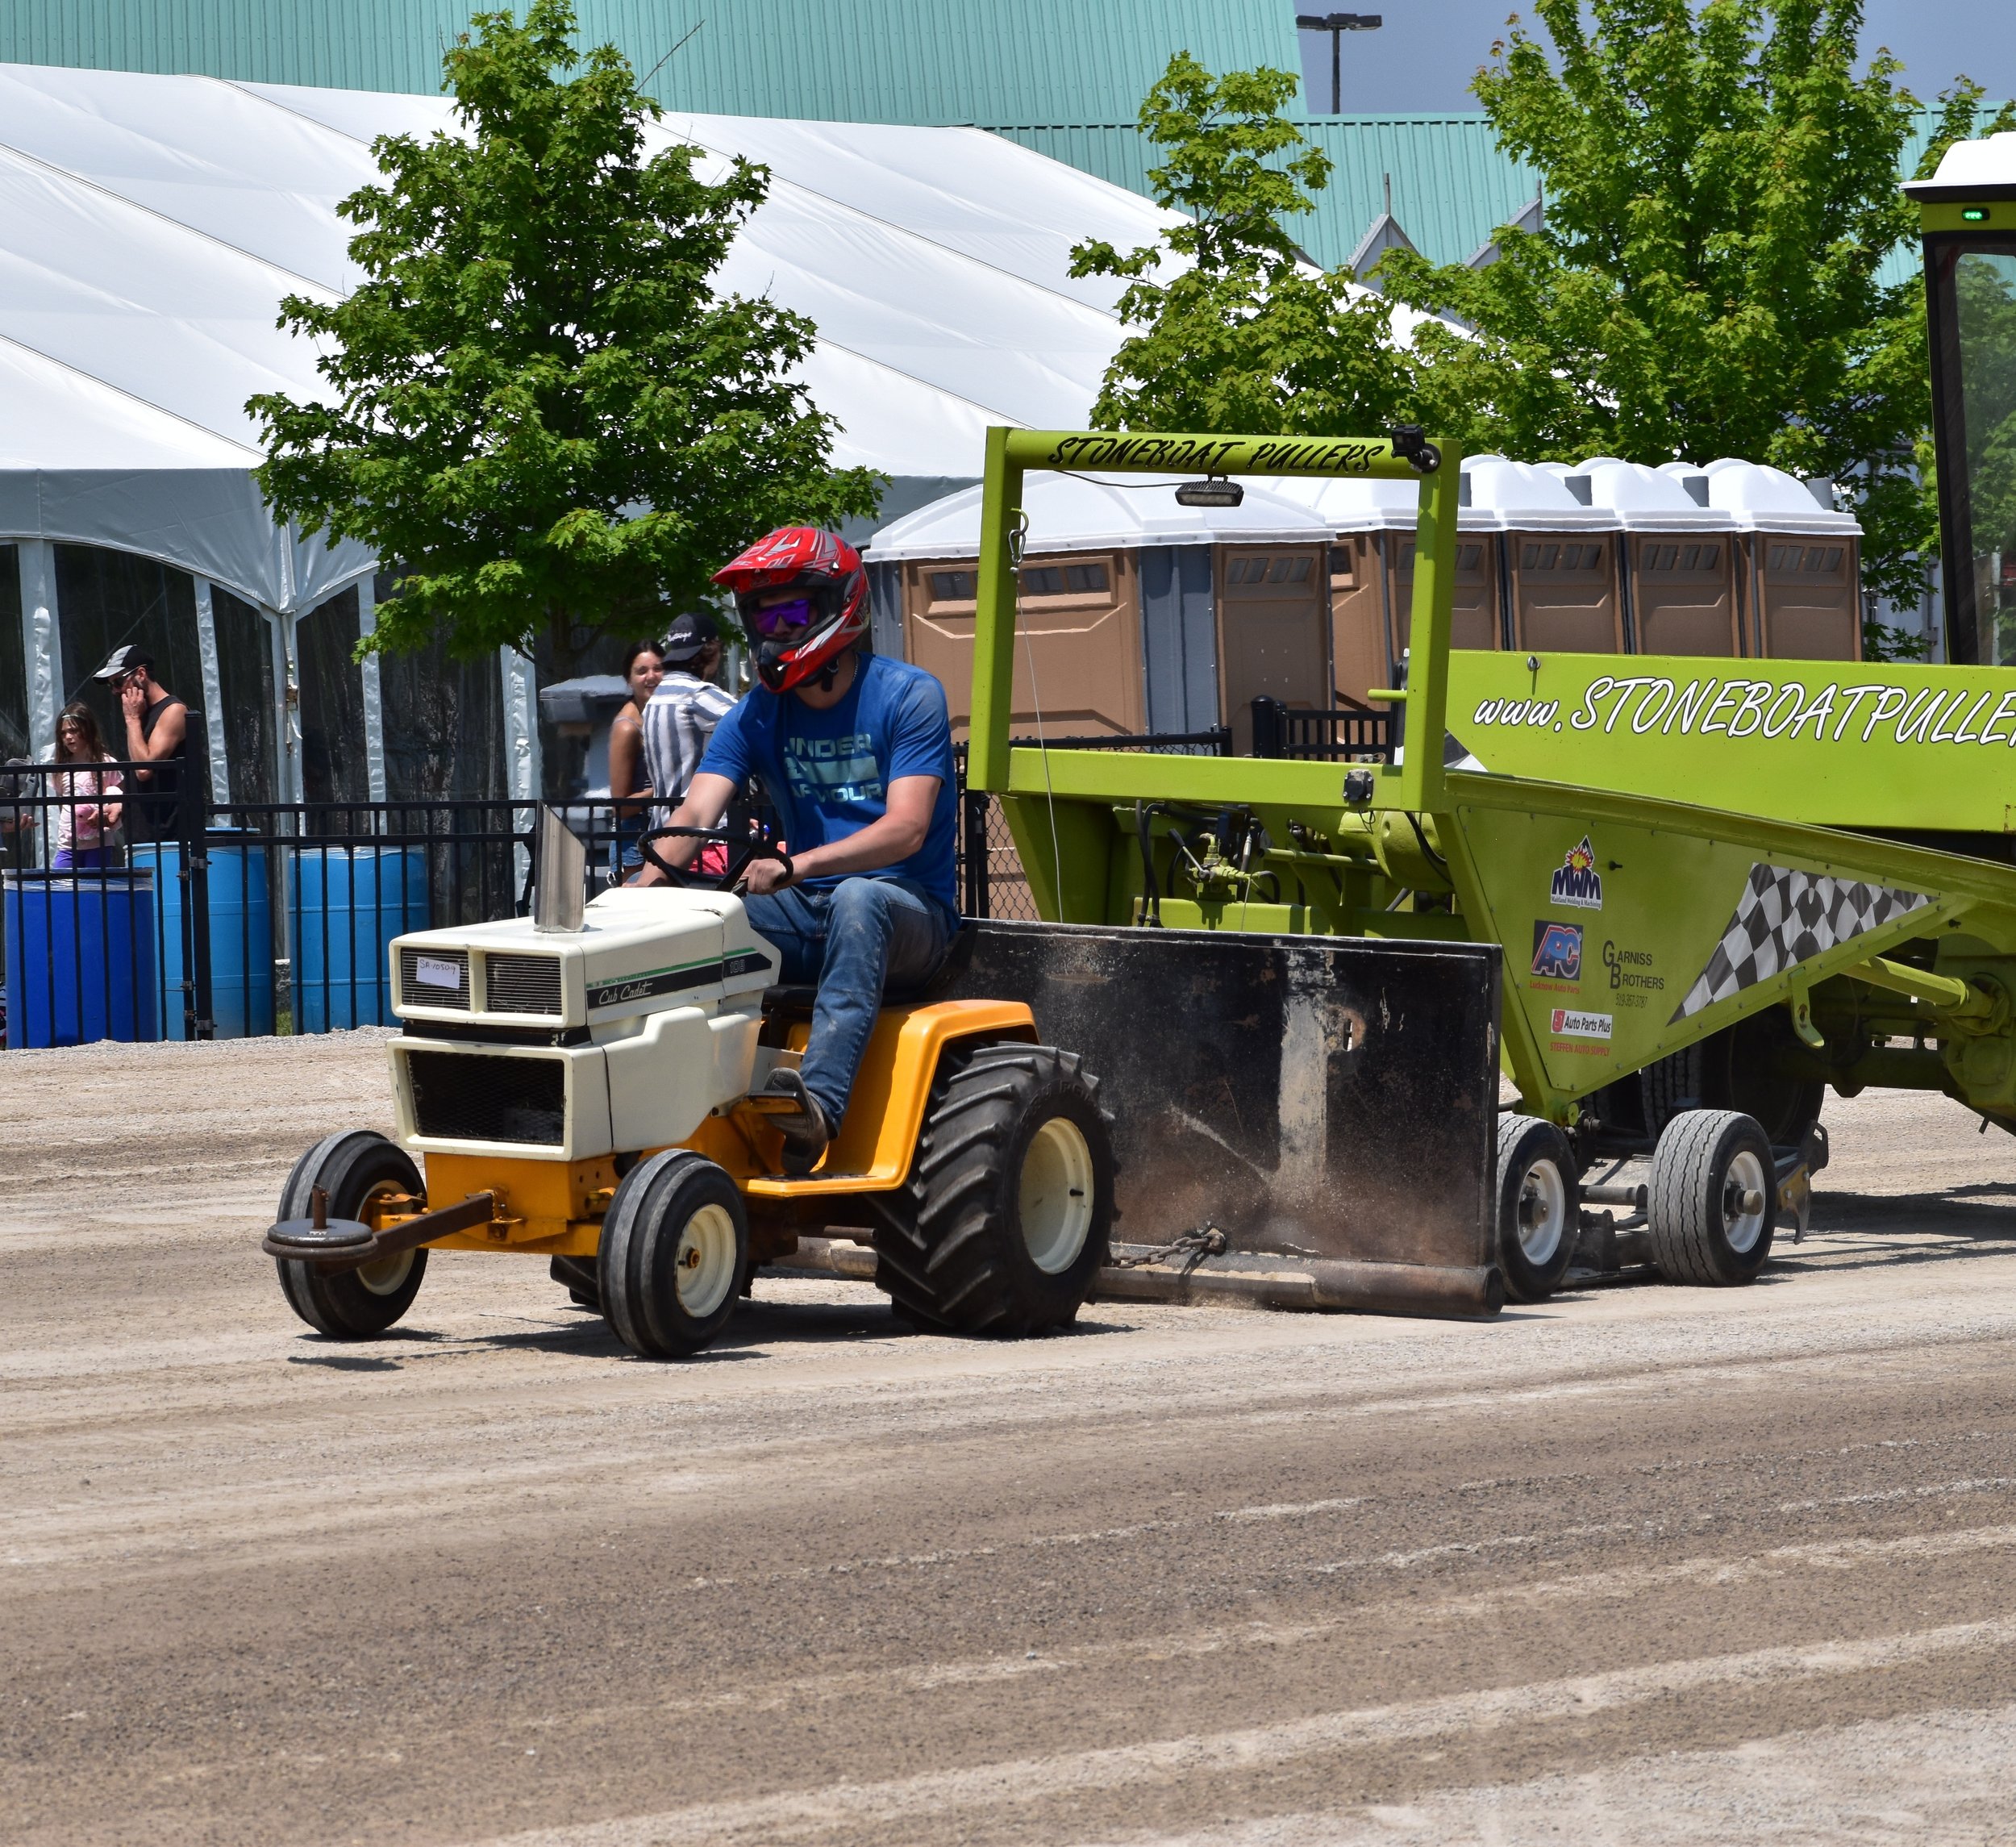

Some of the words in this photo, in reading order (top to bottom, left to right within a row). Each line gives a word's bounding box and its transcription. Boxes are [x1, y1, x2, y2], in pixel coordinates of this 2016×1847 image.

[1049, 436, 1247, 469] STONEBOAT
[1246, 441, 1385, 473] PULLERS
[1472, 675, 2016, 748] www.STONEBOATPULLE
[1551, 863, 1602, 900] MWM
[1531, 924, 1581, 978] APC
[1602, 940, 1653, 967] GARNISS
[729, 959, 746, 974] 108
[1610, 963, 1665, 990] BROTHERS
[598, 989, 619, 1006] Cub
[619, 981, 653, 1001] Cadet
[1530, 980, 1552, 991] Lucknow
[1553, 983, 1566, 992] Auto
[1567, 984, 1581, 994] Parts
[1564, 1015, 1581, 1030] Auto
[1581, 1017, 1597, 1032] Parts
[1597, 1019, 1611, 1033] Plus
[1574, 1044, 1589, 1054] AUTO
[1589, 1046, 1610, 1057] SUPPLY
